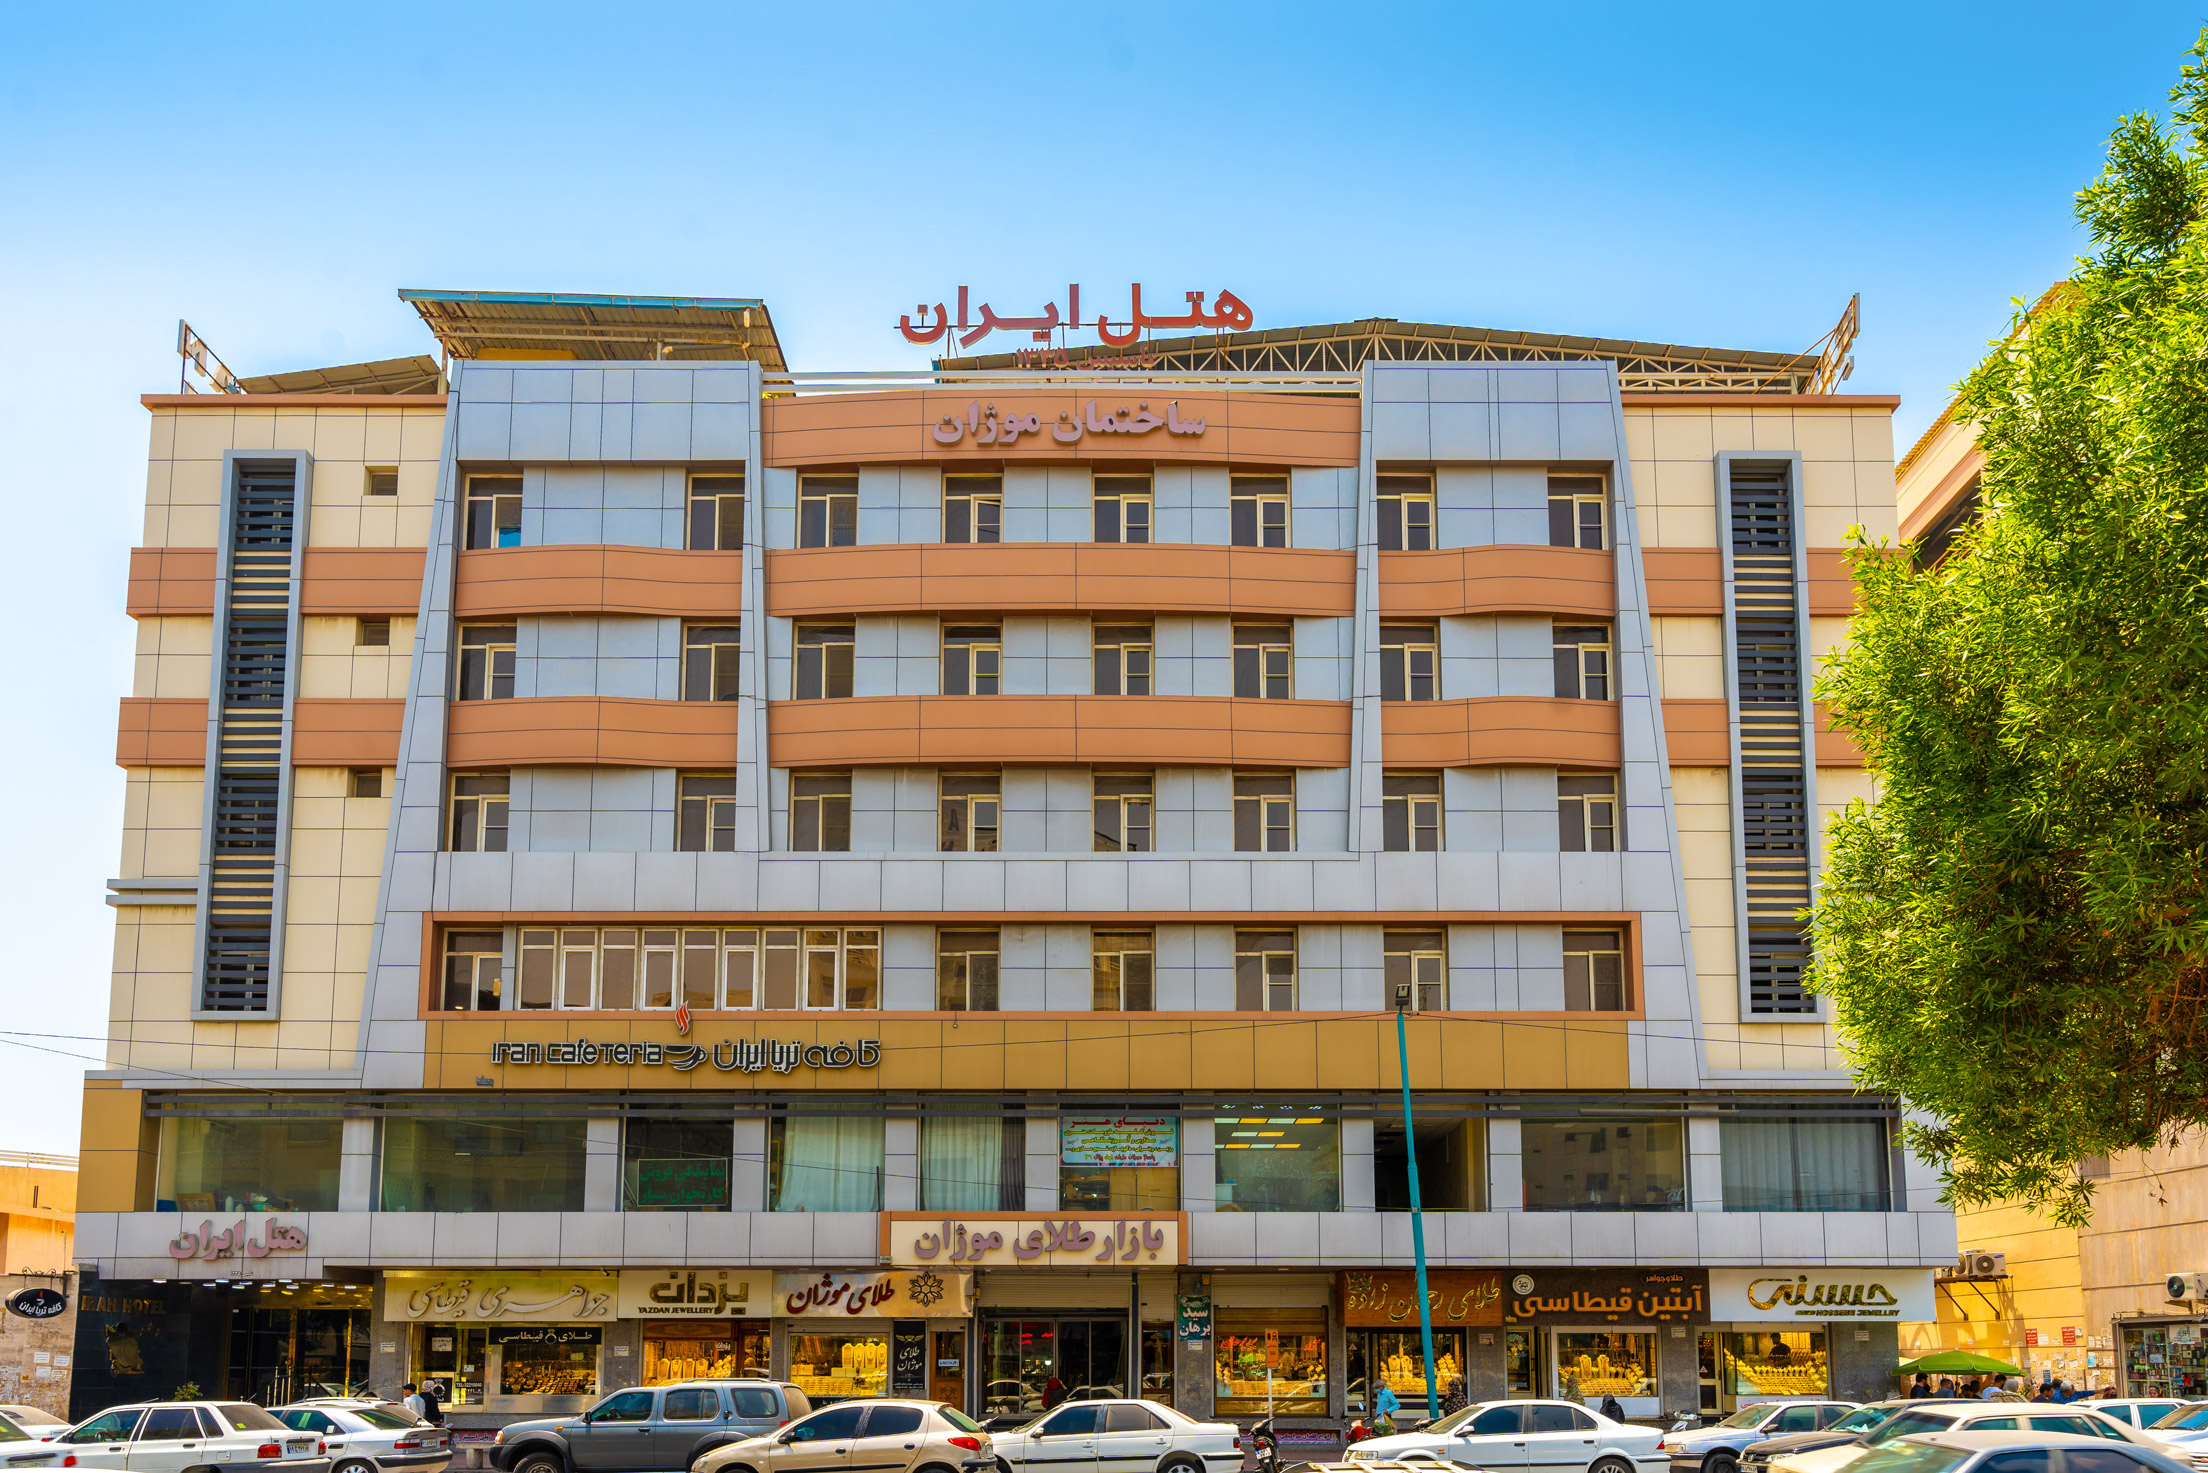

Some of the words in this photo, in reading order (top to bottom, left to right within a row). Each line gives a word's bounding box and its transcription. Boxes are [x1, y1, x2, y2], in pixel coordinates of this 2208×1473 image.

[900, 283, 1080, 349] ایران
[1098, 282, 1254, 348] هتل
[932, 400, 1041, 447] موژان
[1052, 400, 1207, 446] ساختمان
[712, 1037, 769, 1074] ایران
[770, 1039, 801, 1075] تریا
[803, 1039, 882, 1068] کافه
[640, 1162, 673, 1181] فروش
[675, 1162, 725, 1181] نمایندگی
[641, 1187, 666, 1204] سیار
[669, 1186, 725, 1204] کارتخوان
[169, 1219, 246, 1260] ایران
[247, 1217, 308, 1257] هتل
[914, 1219, 1004, 1261] موژان
[1013, 1219, 1096, 1260] طلای
[1096, 1219, 1164, 1261] بازار
[81, 1295, 118, 1311] IRAN
[123, 1298, 168, 1315] HOTEL
[407, 1280, 471, 1318] قیطاسی
[476, 1284, 609, 1318] جواهری
[649, 1271, 749, 1315] یزدان
[786, 1272, 850, 1314] موژان
[846, 1278, 895, 1315] طلای
[1514, 1287, 1632, 1321] قیطاسی
[1638, 1285, 1702, 1320] آبتین
[1180, 1321, 1211, 1337] برهان
[1182, 1307, 1209, 1321] سید
[1816, 1309, 1856, 1317] HOSSEINI
[499, 1331, 543, 1344] قیطاسی
[558, 1331, 593, 1344] طلای
[899, 1345, 920, 1360] طلای
[897, 1359, 923, 1372] موژان
